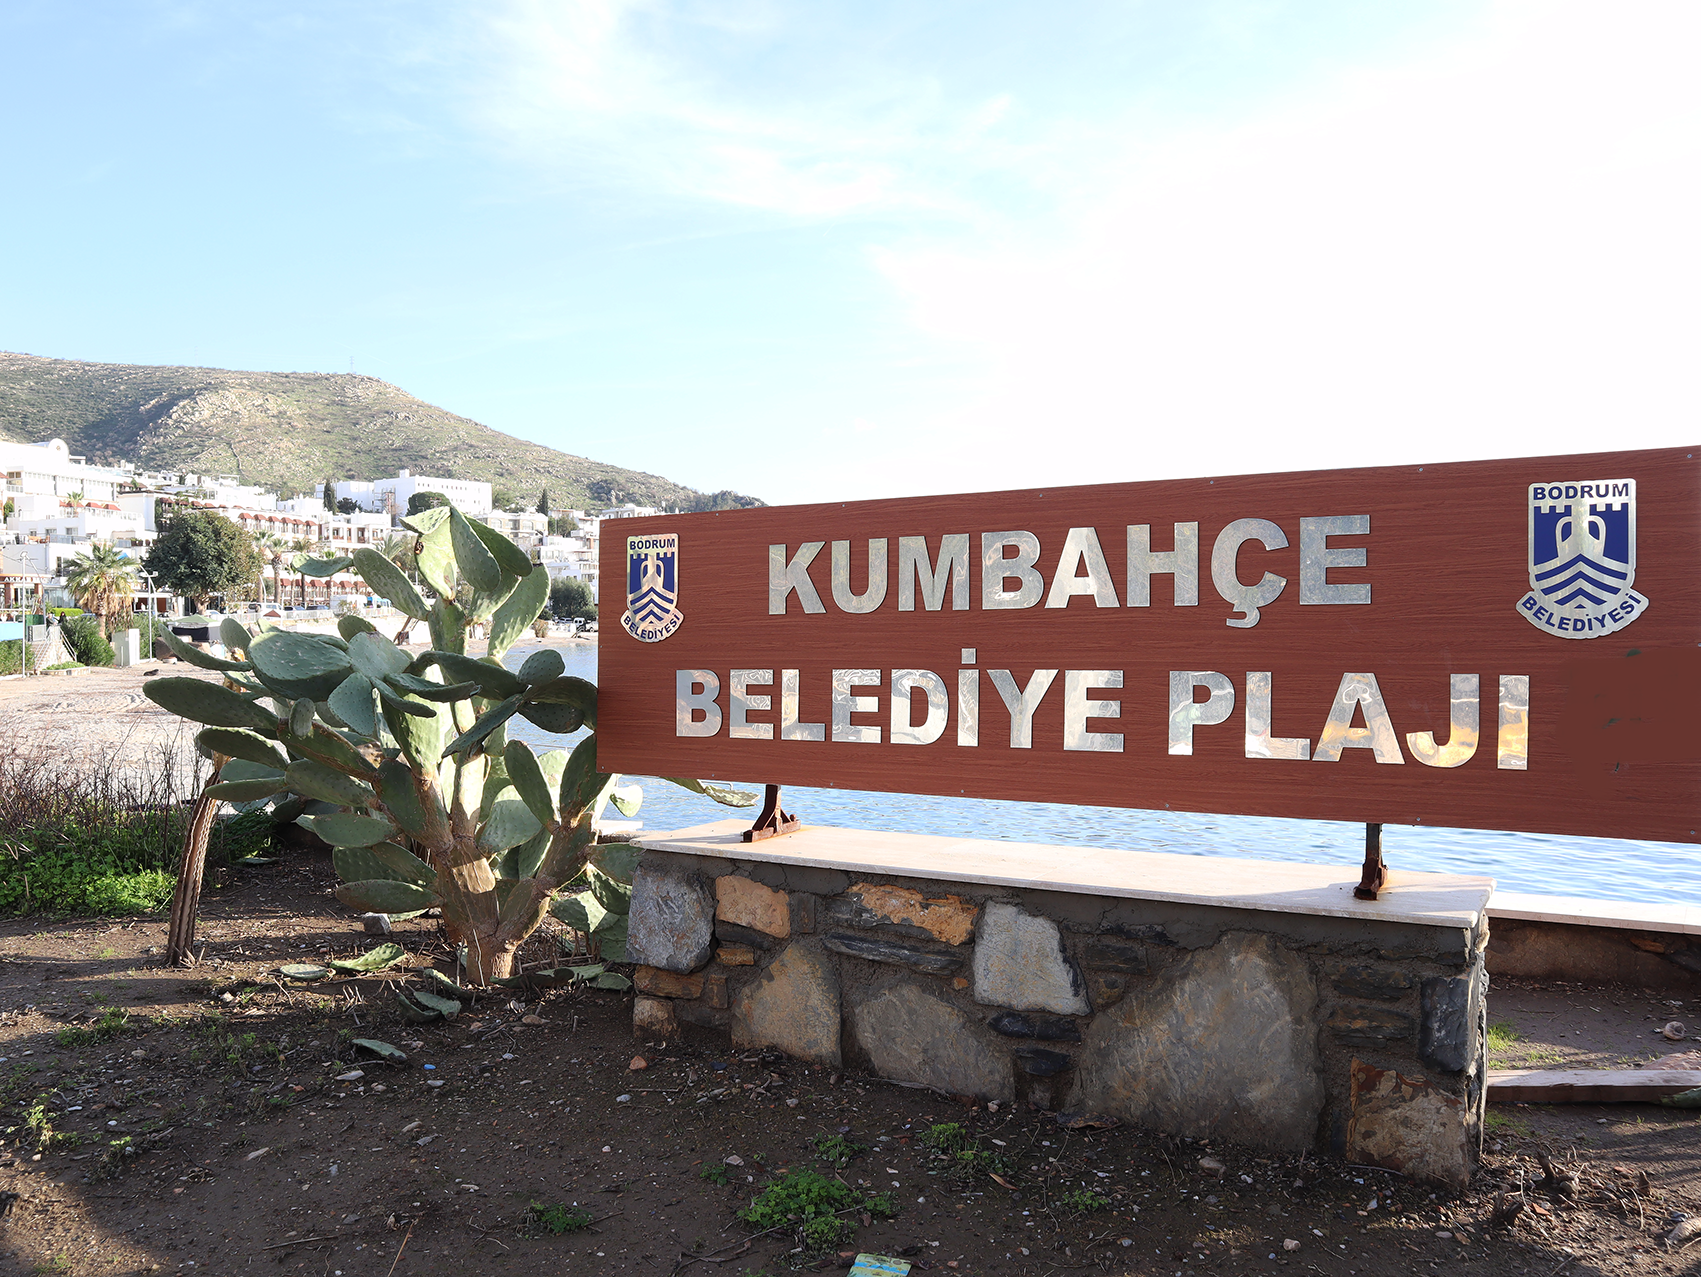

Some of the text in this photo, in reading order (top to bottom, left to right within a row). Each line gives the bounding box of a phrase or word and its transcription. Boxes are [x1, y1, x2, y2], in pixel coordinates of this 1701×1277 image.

[1533, 483, 1629, 501] BODRUM
[630, 538, 675, 550] BODRUM
[768, 514, 1371, 629] KUMBAHÇE
[623, 612, 681, 640] BELEDİYESİ
[1521, 592, 1642, 632] BELEDİYESİ
[675, 647, 1530, 770] BELEDİYE PLAJI
